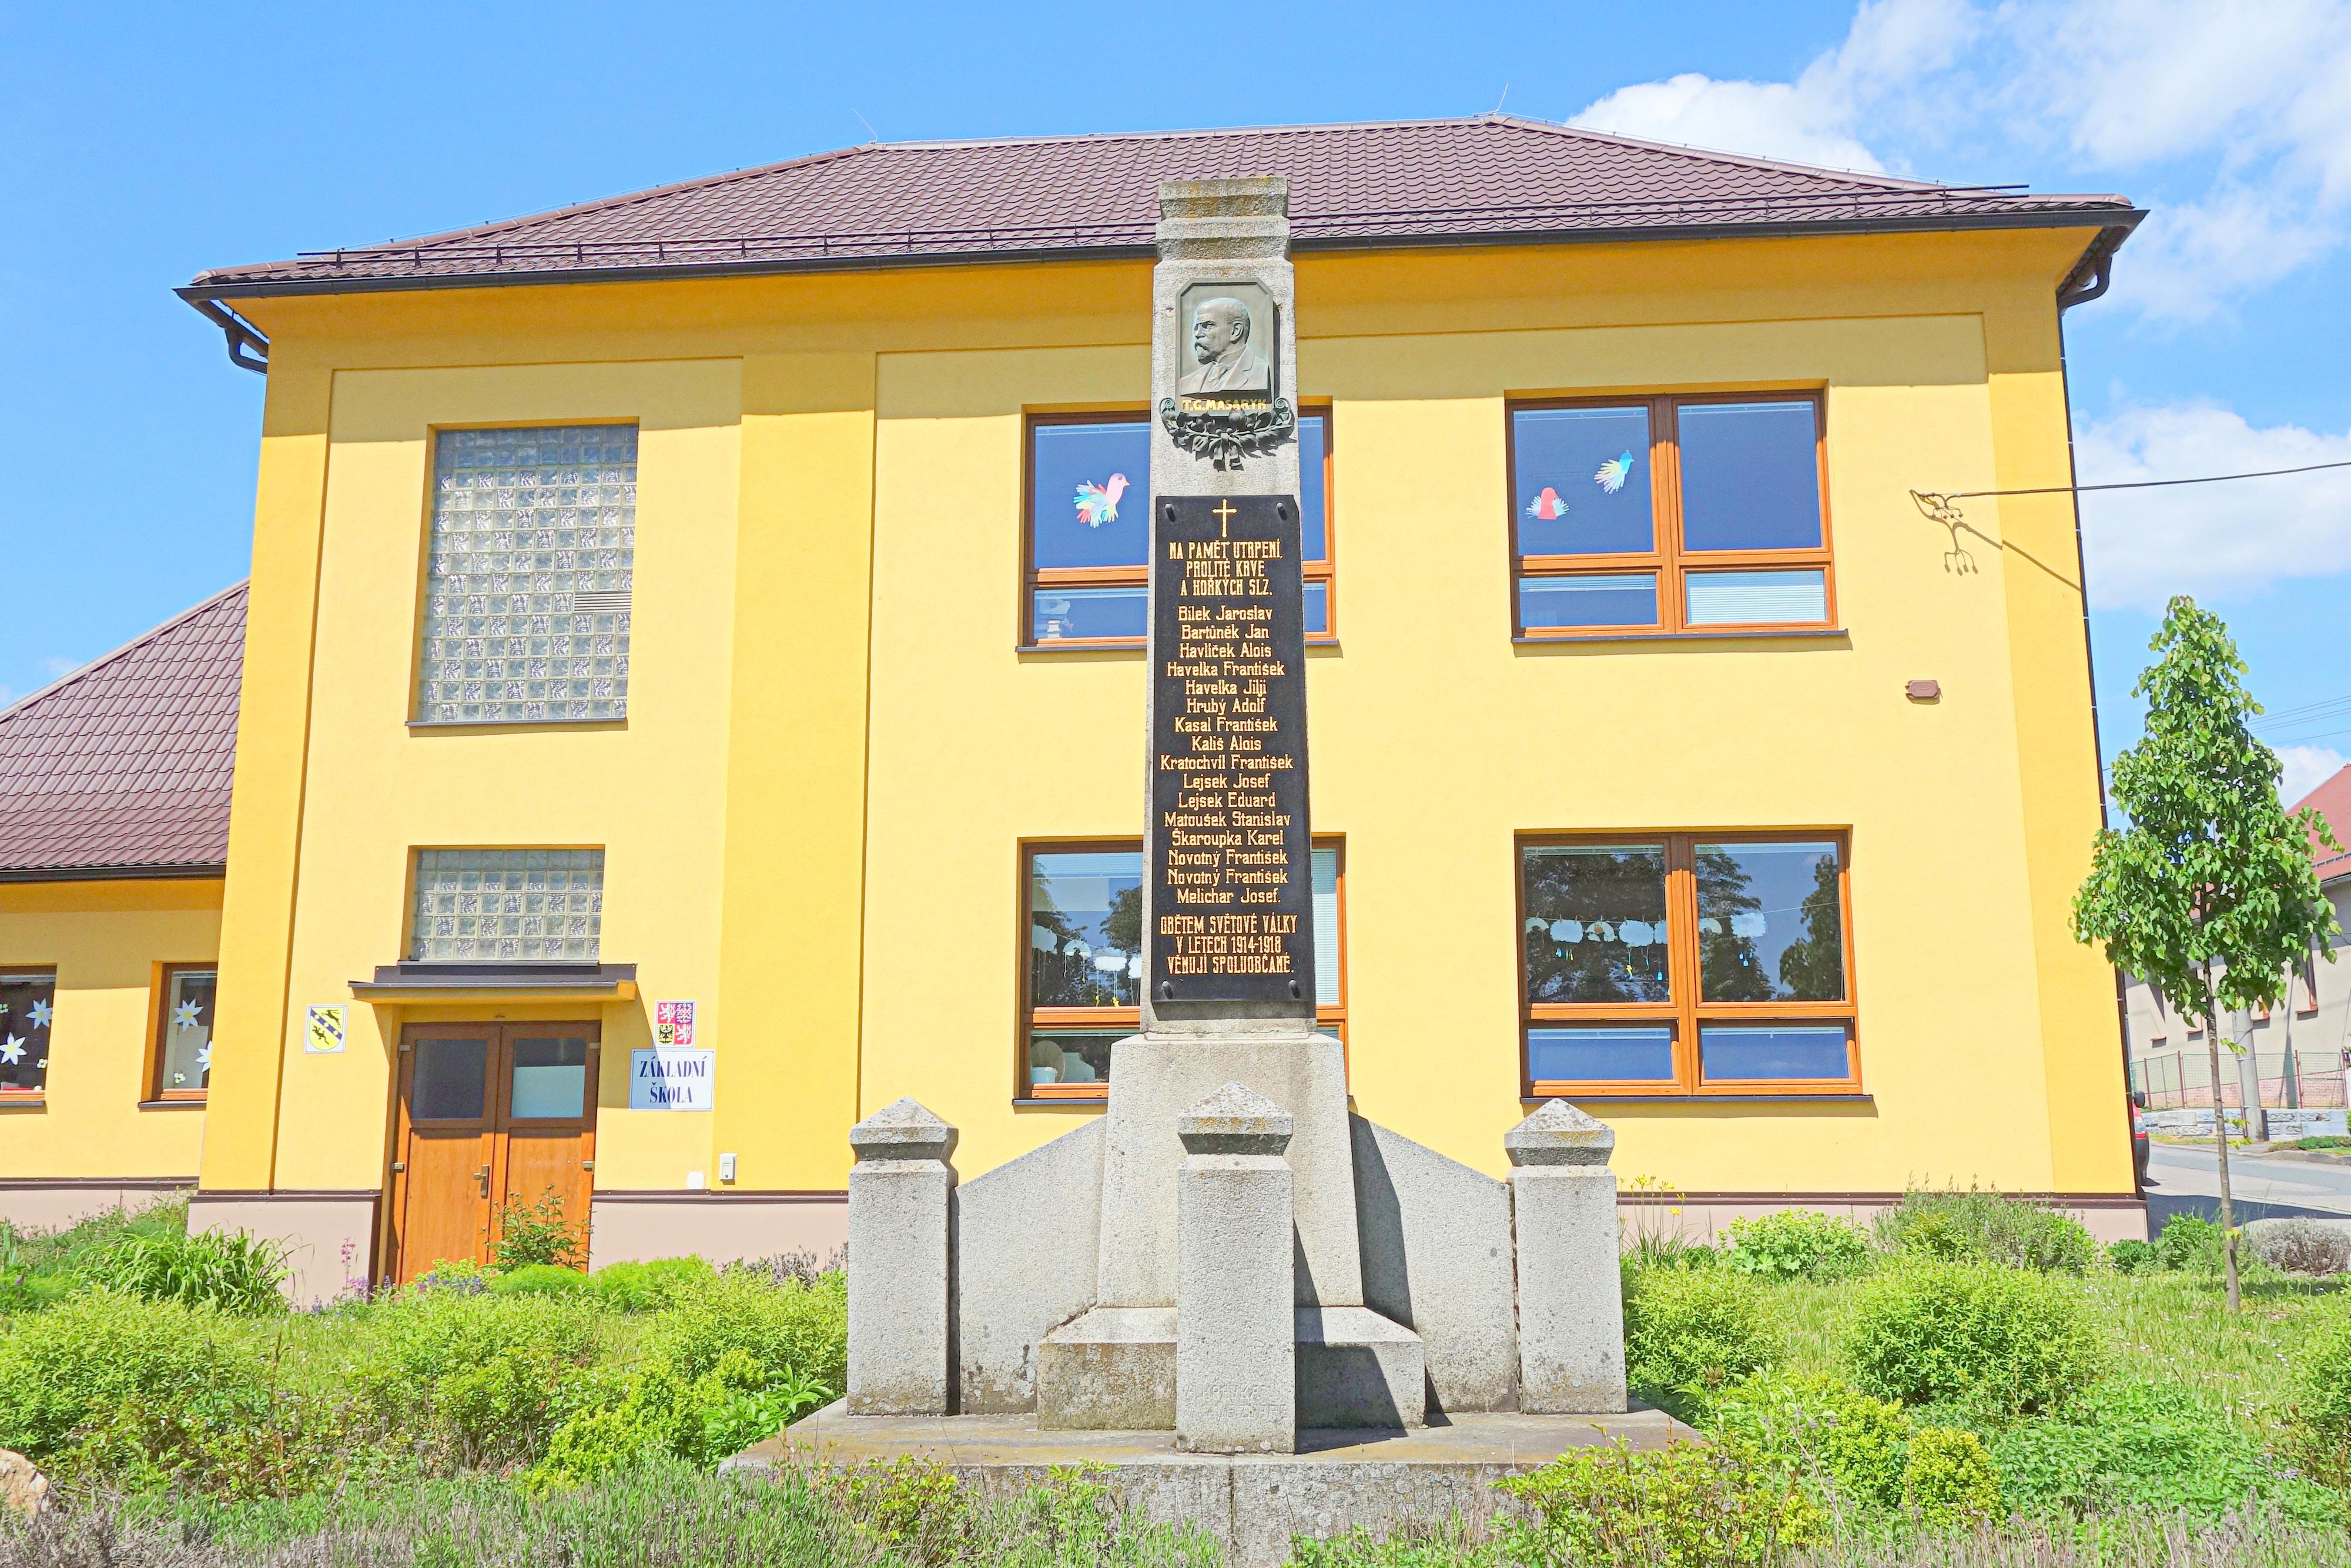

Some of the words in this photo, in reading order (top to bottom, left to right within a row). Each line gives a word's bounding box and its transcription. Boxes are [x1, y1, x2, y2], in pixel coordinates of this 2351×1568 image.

[1169, 542, 1184, 559] NA
[1233, 538, 1284, 559] UTRPENÍ,
[1186, 558, 1231, 578] PROLITÉ
[1236, 561, 1265, 577] KRVE
[1180, 579, 1188, 596] A
[1193, 576, 1244, 596] HOŘKÝCH
[1249, 579, 1273, 595] SLZ.
[1178, 605, 1211, 621] Bílek
[1215, 605, 1273, 621] Jaroslav
[1181, 624, 1240, 639] Bartůněk
[1245, 624, 1270, 639] Jan
[1240, 642, 1272, 658] Alois
[1167, 662, 1218, 676] Havelka
[1223, 661, 1285, 676] František
[1185, 679, 1237, 695] Havelka
[1186, 698, 1227, 715] Hrubý
[1232, 698, 1267, 713] Adolf
[1175, 716, 1212, 732] Kasal
[1216, 716, 1278, 732] František
[1191, 735, 1224, 751] Kališ
[1230, 735, 1261, 751] Alois
[1231, 754, 1294, 769] František
[1183, 773, 1228, 792] Lejsek
[1233, 773, 1271, 789] Josef
[1178, 792, 1223, 810] Lejsek
[1227, 792, 1275, 808] Eduard
[1164, 811, 1227, 827] Matoušek
[1232, 810, 1291, 826] Stanislav
[1172, 827, 1243, 848] Škaroupka
[1247, 830, 1284, 845] Karel
[1168, 849, 1221, 867] Novotný
[1225, 849, 1288, 865] František
[1167, 869, 1221, 887] Novotný
[1225, 868, 1288, 884] František
[1177, 888, 1234, 904] Melichar
[1240, 887, 1281, 903] Josef.
[1160, 914, 1204, 934] OBĚTEM
[1210, 912, 1258, 934] SVĚTOVÉ
[1262, 912, 1298, 933] VÁLKY
[1176, 936, 1184, 954] V
[1188, 936, 1227, 954] LETECH
[1231, 936, 1281, 953] 1914-1918
[1167, 954, 1208, 974] VĚNUJÍ
[1212, 952, 1294, 973] SPOLUOBČANÉ.
[639, 1056, 707, 1077] ZÁKLADNÍ
[649, 1081, 692, 1103] ŠKOLA
